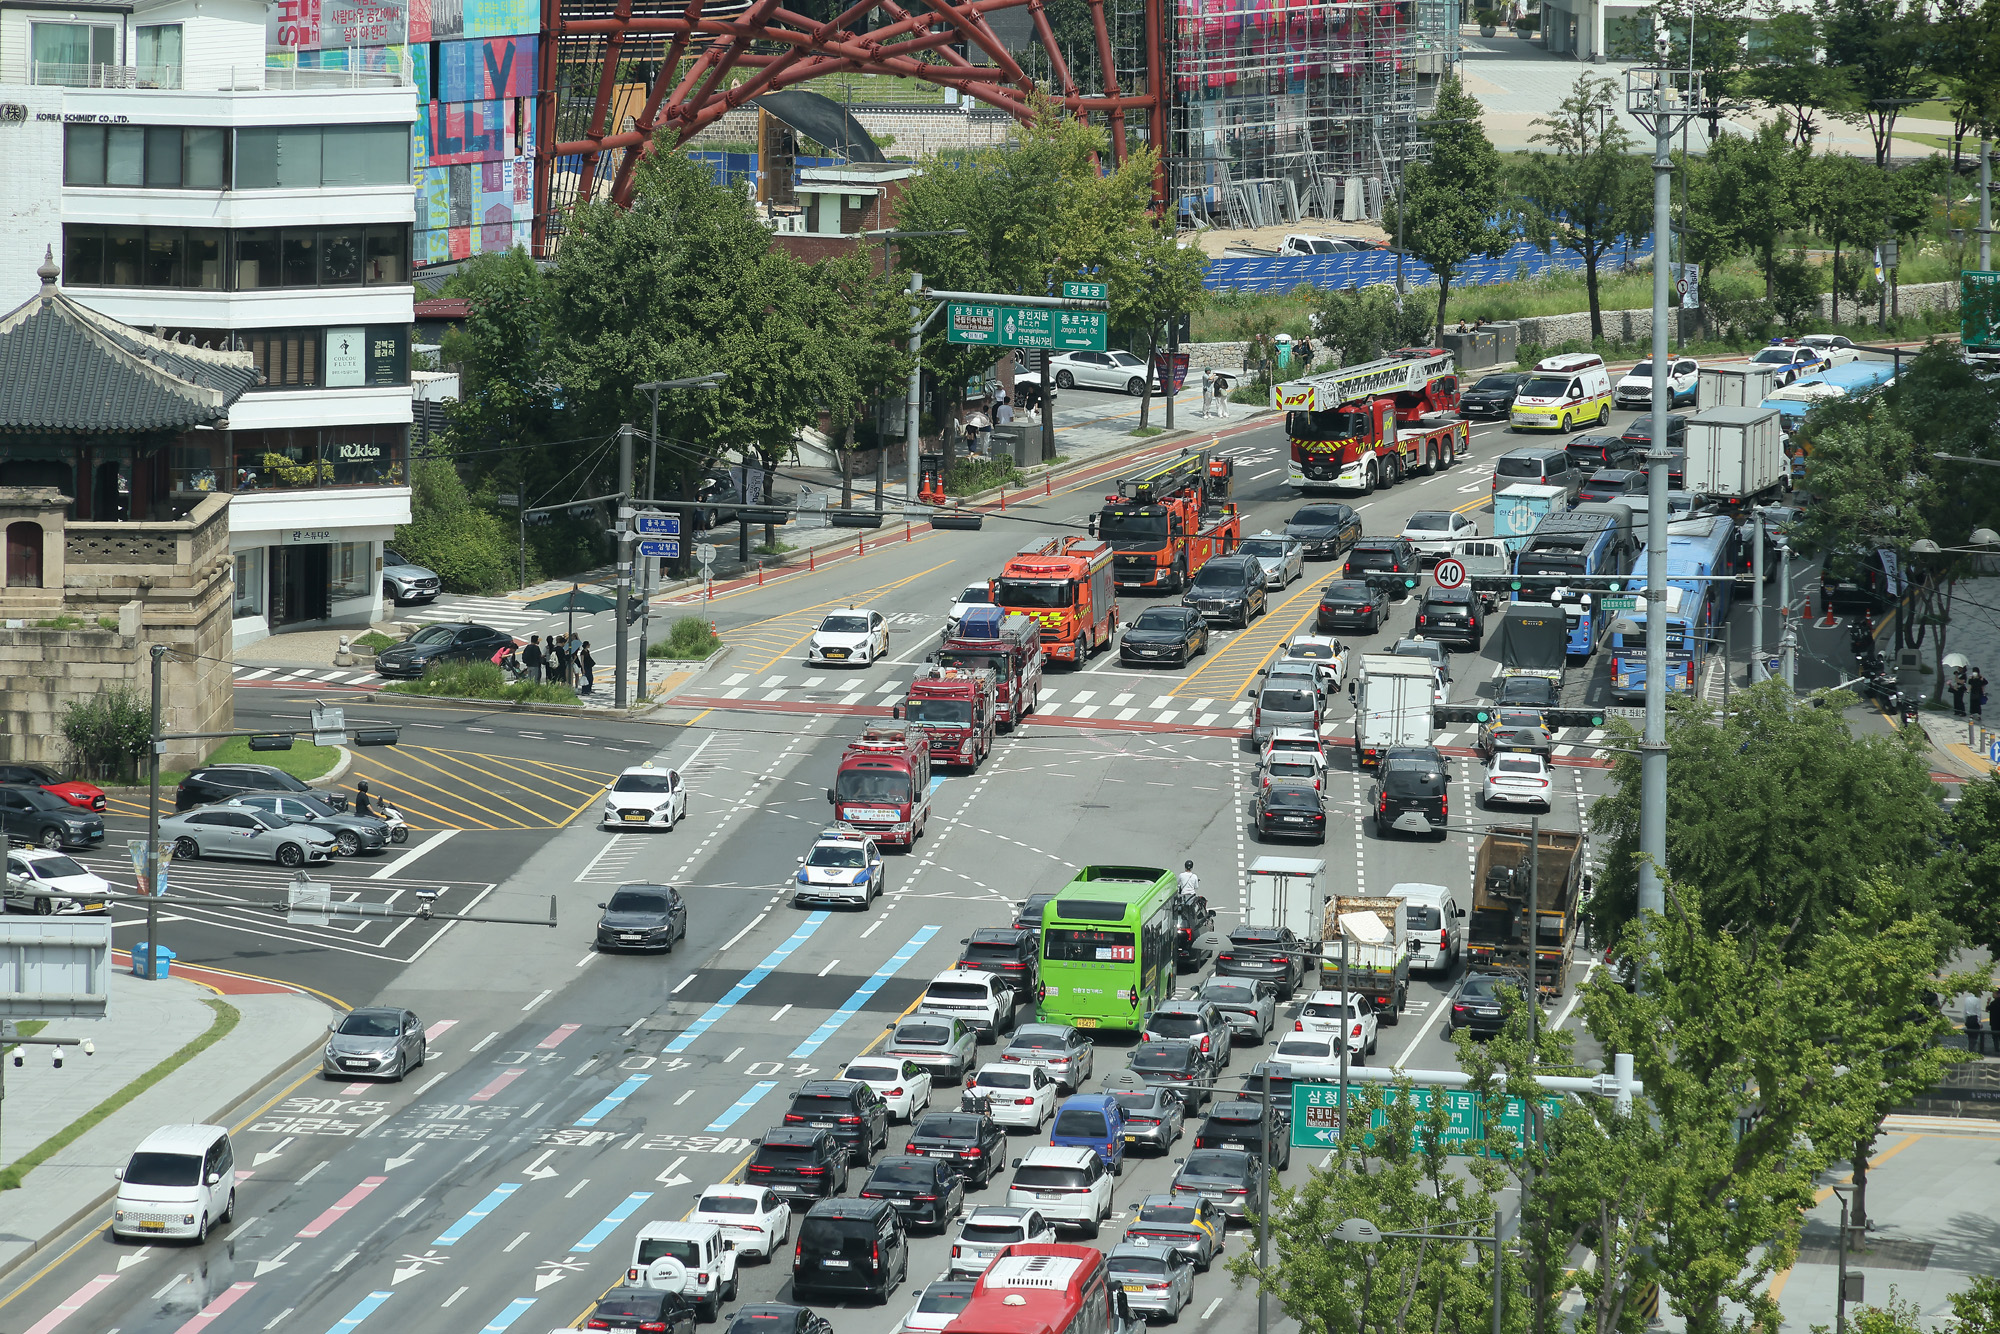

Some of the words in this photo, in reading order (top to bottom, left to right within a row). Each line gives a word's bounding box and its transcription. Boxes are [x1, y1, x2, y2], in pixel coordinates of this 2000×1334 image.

[332, 8, 364, 24] 사람다운
[367, 6, 399, 23] 공간에서
[371, 25, 388, 40] 한다
[36, 113, 61, 121] KOREA
[64, 113, 96, 122] SCHMIDT
[504, 161, 512, 186] THE
[472, 165, 482, 253] COMPLEXITY
[1070, 285, 1100, 296] 경복궁
[955, 306, 994, 317] 삼청터널
[1061, 314, 1099, 326] 종로구청
[374, 339, 395, 349] 경복궁
[1284, 393, 1307, 405] 119
[293, 531, 301, 541] 란
[304, 531, 330, 540] 스튜디오
[1440, 565, 1459, 582] 40
[1607, 708, 1618, 716] 직진
[1621, 709, 1627, 717] 후
[1119, 948, 1132, 958] 11
[743, 1061, 820, 1078] 40
[1308, 1119, 1331, 1128] National
[640, 1133, 751, 1154] 세종로
